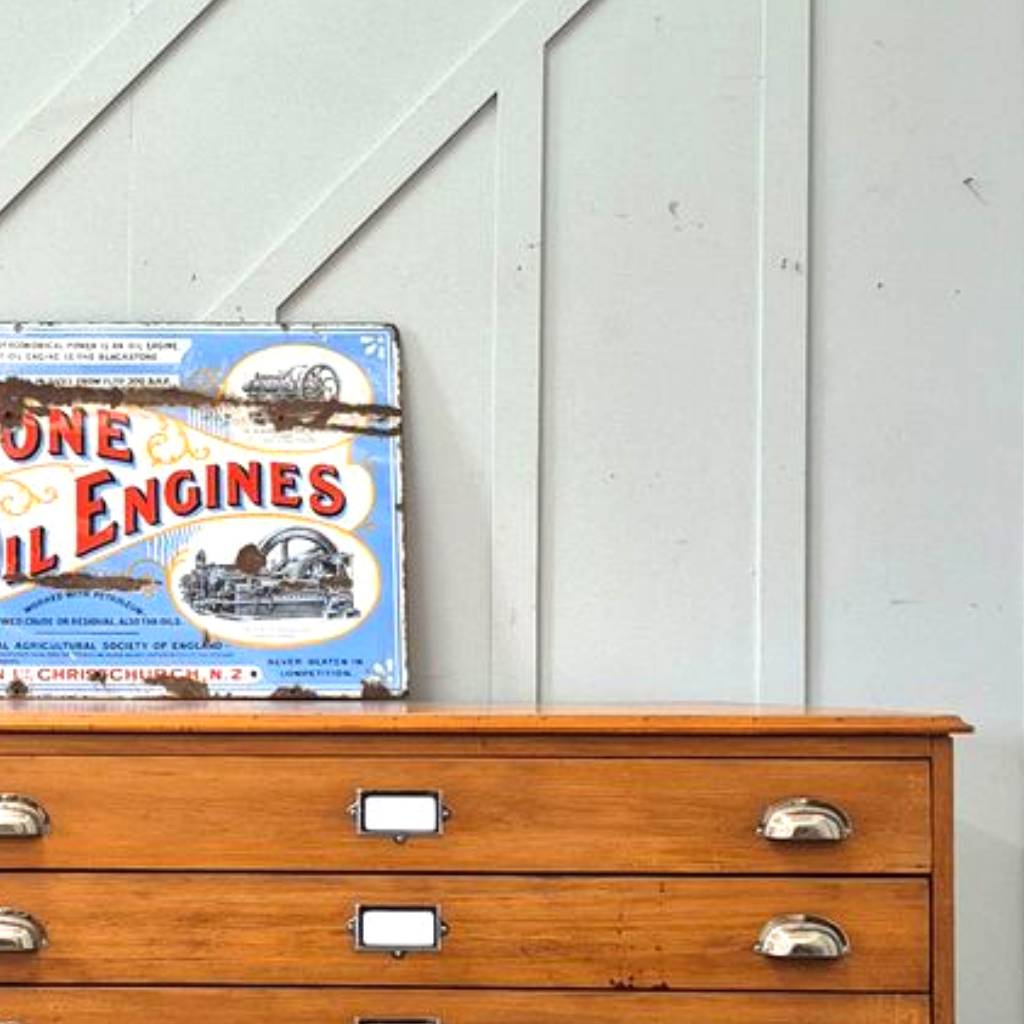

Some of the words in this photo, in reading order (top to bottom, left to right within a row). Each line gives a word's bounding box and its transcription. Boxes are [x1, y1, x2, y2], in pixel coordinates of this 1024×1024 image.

[75, 461, 348, 557] ENGINES
[14, 641, 97, 650] AGRICULTURAL
[102, 641, 148, 650] SOCIETY
[152, 641, 167, 650] OF
